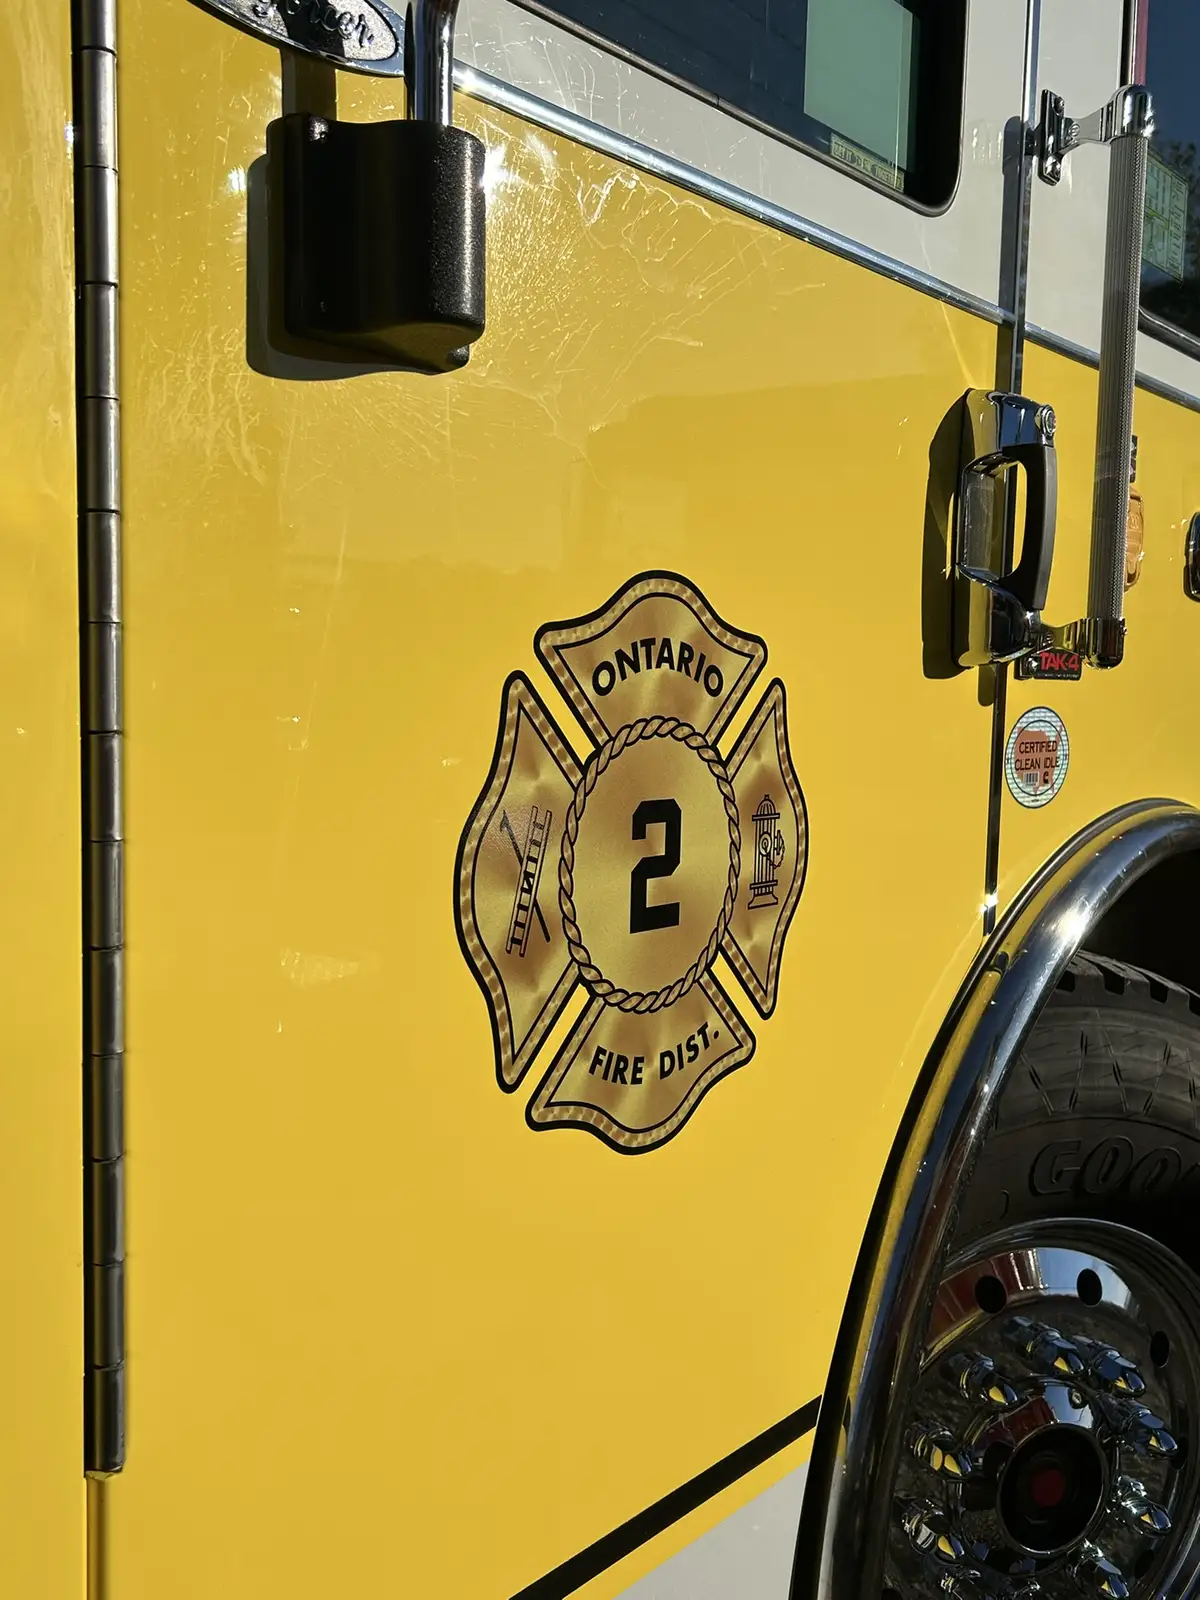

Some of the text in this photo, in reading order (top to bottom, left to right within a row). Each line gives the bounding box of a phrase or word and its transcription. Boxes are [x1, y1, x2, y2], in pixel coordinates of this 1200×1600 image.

[592, 637, 724, 697] ONTARIO
[1040, 652, 1080, 671] TAK-4
[1014, 757, 1041, 771] CLEAN
[1043, 756, 1061, 769] IDLE
[1018, 740, 1058, 754] CERTIFIED
[630, 798, 682, 934] 2
[588, 1021, 720, 1085] FIRE DIST.
[1028, 1135, 1200, 1197] GOO
